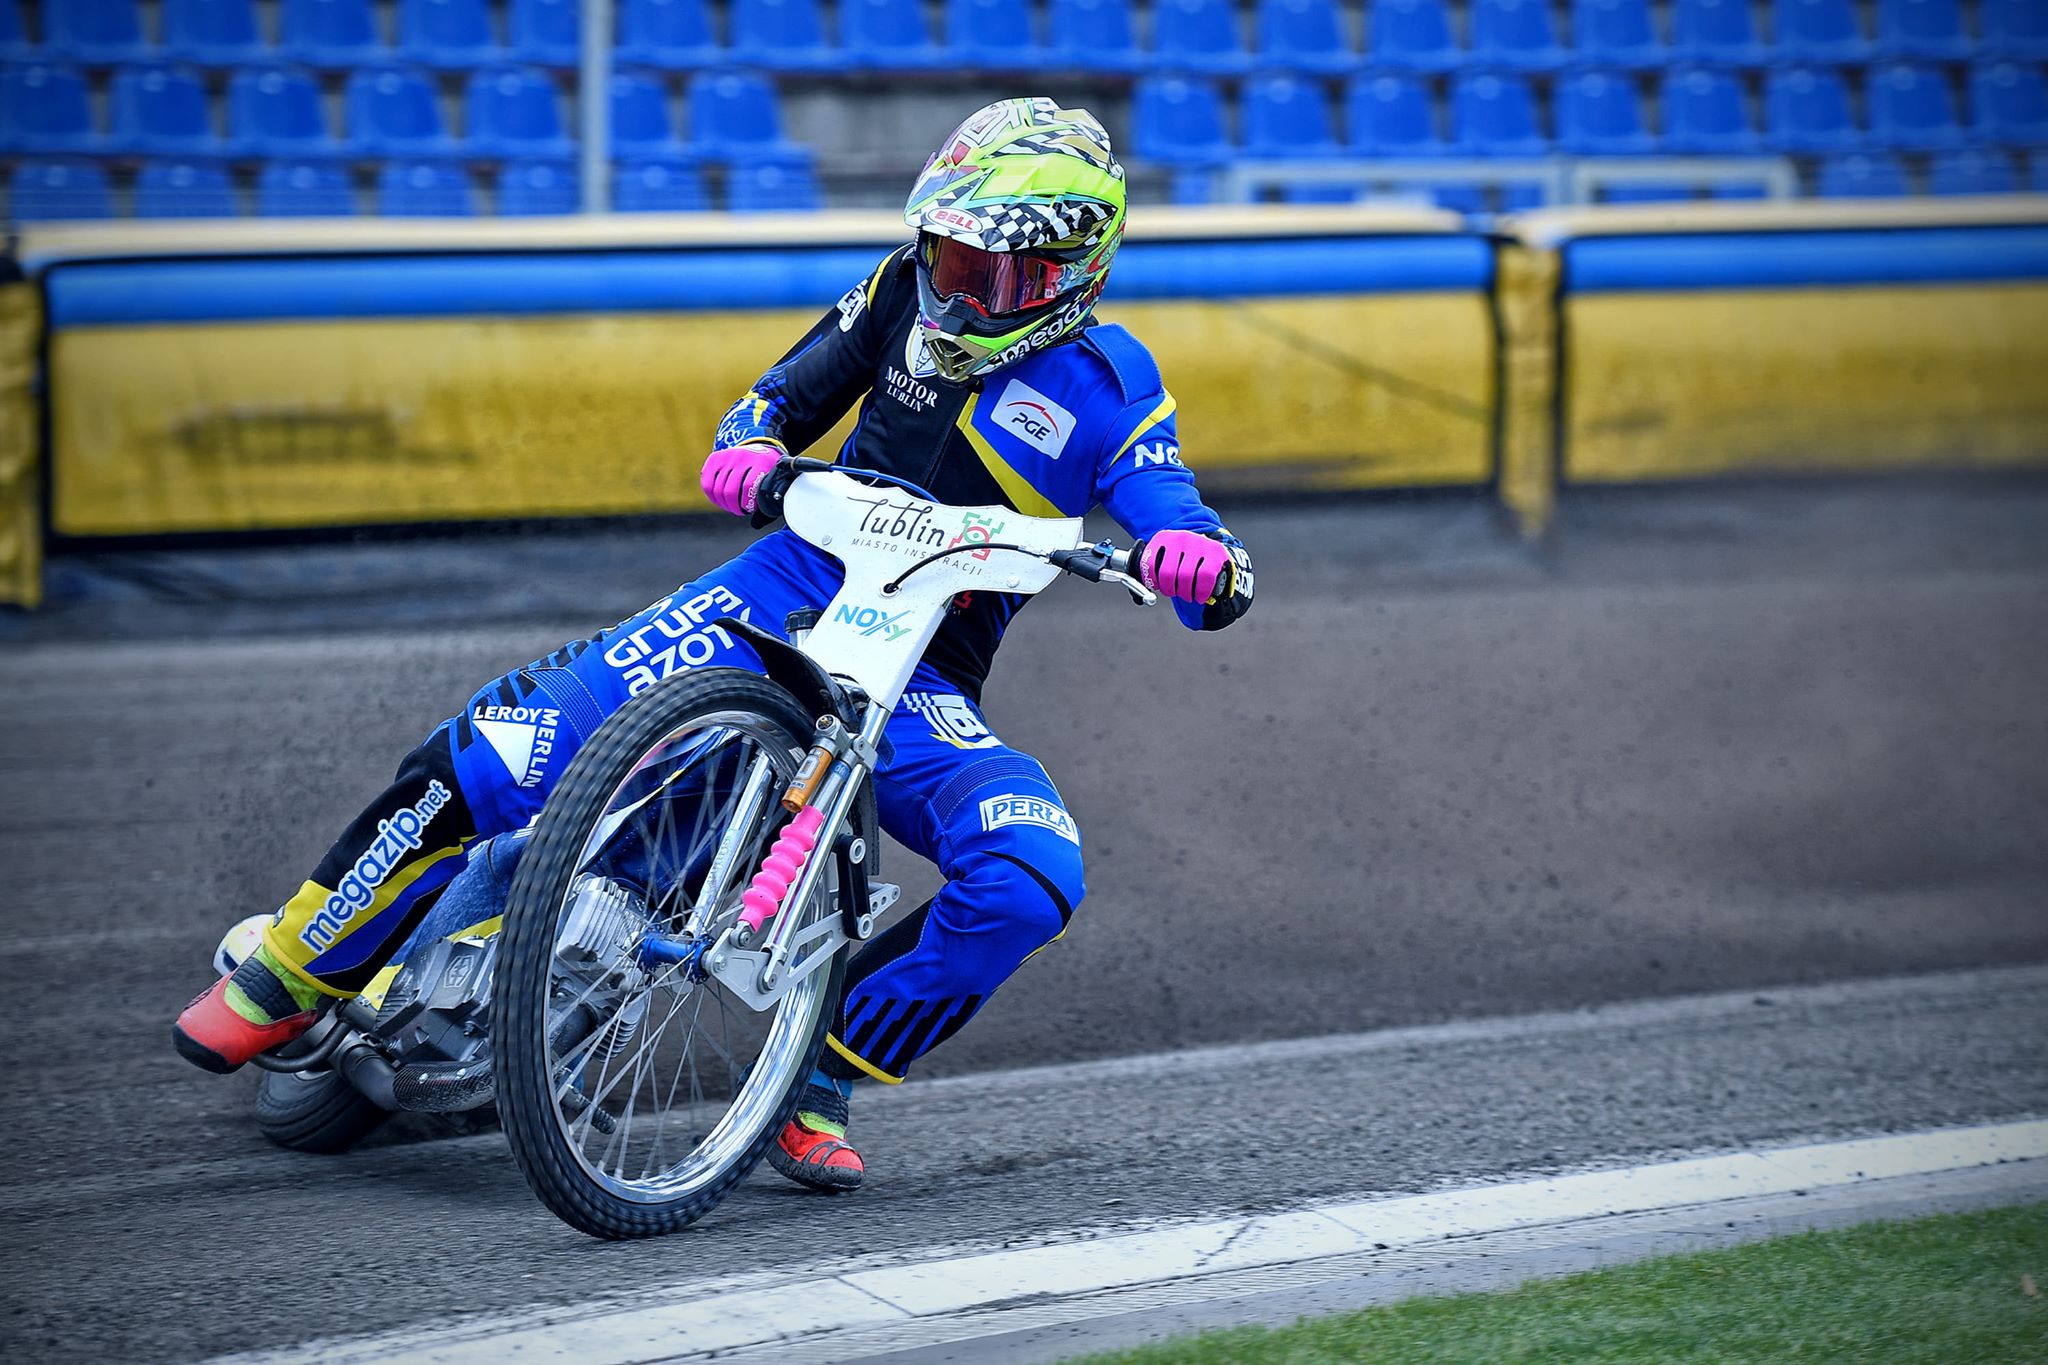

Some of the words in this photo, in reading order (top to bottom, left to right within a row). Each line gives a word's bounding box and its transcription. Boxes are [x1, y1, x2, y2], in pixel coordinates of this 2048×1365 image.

[934, 210, 974, 230] BELL
[885, 366, 938, 408] MOTOR
[886, 386, 925, 412] LUBLIN
[1011, 412, 1051, 441] PGE
[851, 538, 898, 553] MIASTO
[904, 547, 983, 576] INSRACJI
[472, 705, 545, 723] LEROY
[529, 707, 560, 788] MERLIN
[991, 800, 1071, 833] PERŁA
[299, 779, 452, 955] megazip.net
